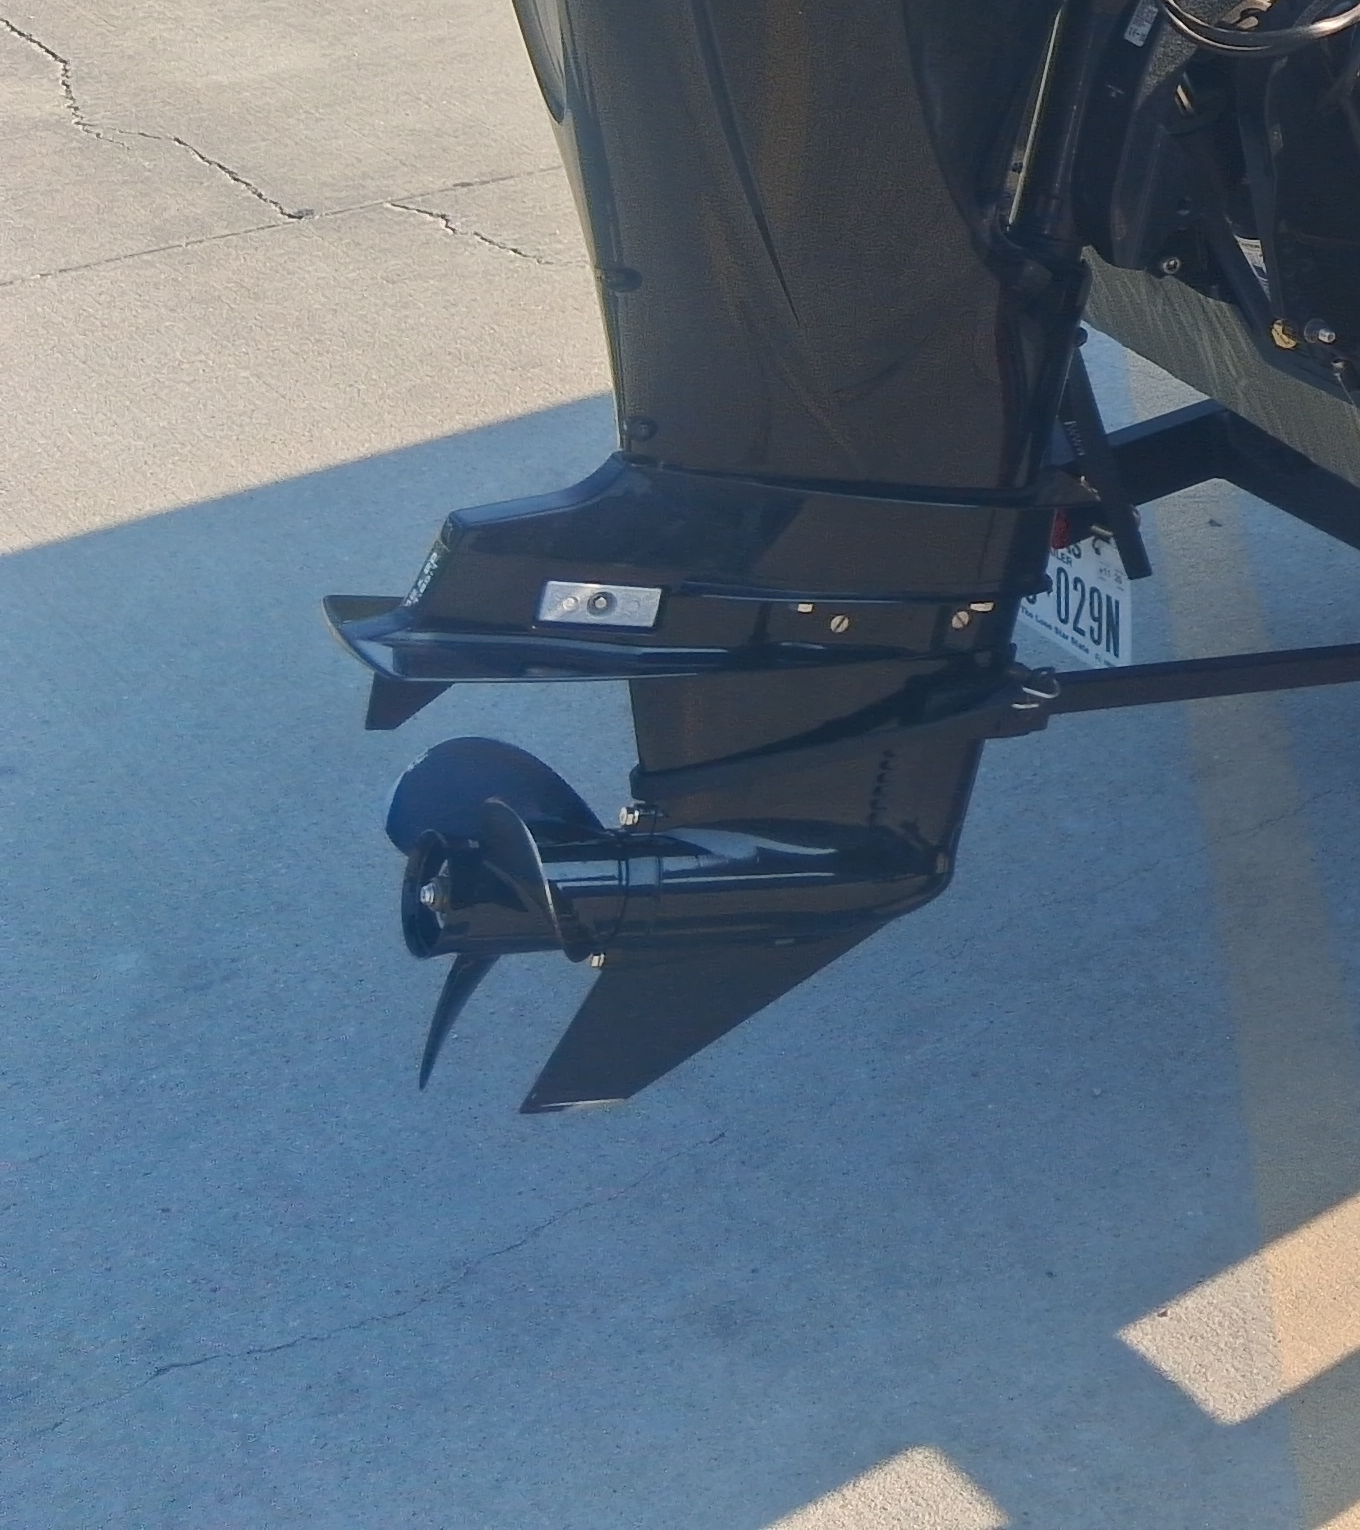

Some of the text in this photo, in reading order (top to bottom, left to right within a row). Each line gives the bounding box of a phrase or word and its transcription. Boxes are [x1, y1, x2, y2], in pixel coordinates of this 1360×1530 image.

[1035, 613, 1052, 630] Lone
[1054, 626, 1069, 641] Star
[1070, 636, 1090, 655] State
